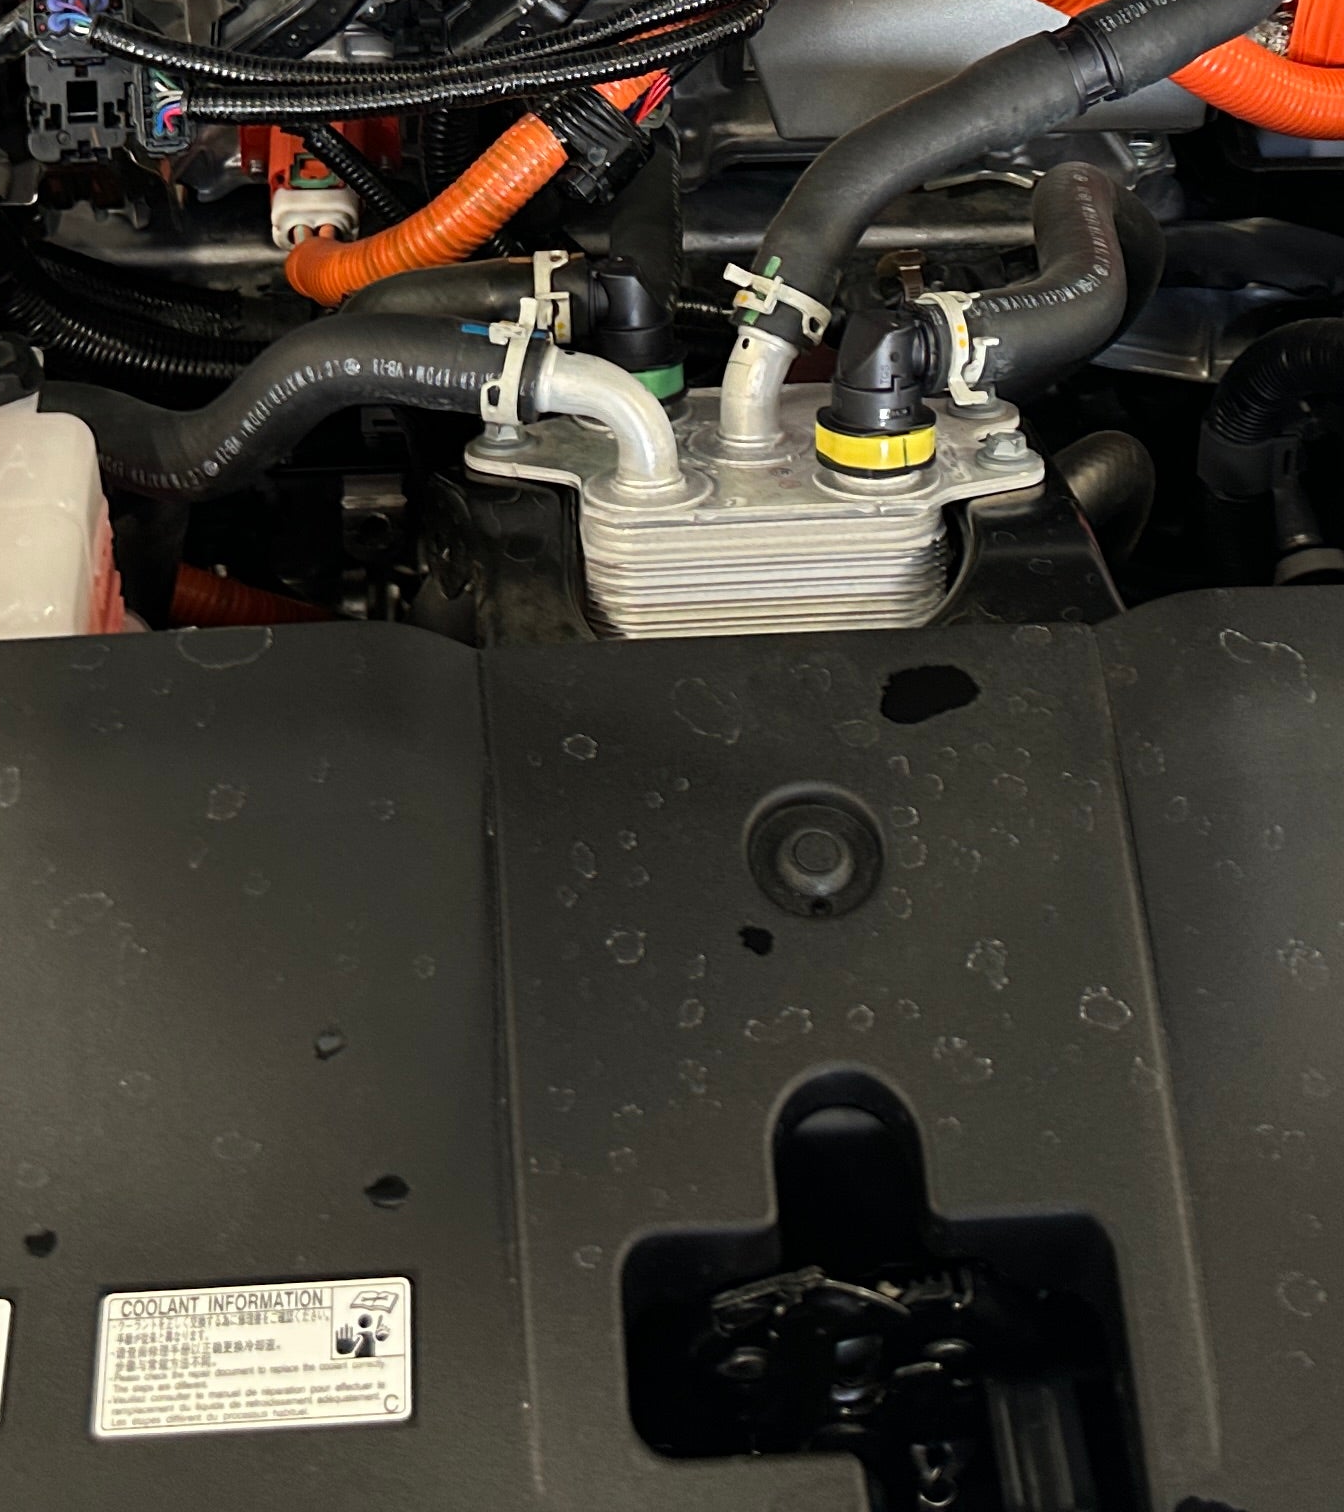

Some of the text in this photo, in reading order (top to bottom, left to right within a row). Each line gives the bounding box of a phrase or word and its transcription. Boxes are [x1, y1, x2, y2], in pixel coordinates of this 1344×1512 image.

[121, 1289, 324, 1318] COOLANT INFORMATION
[383, 1393, 400, 1414] C
